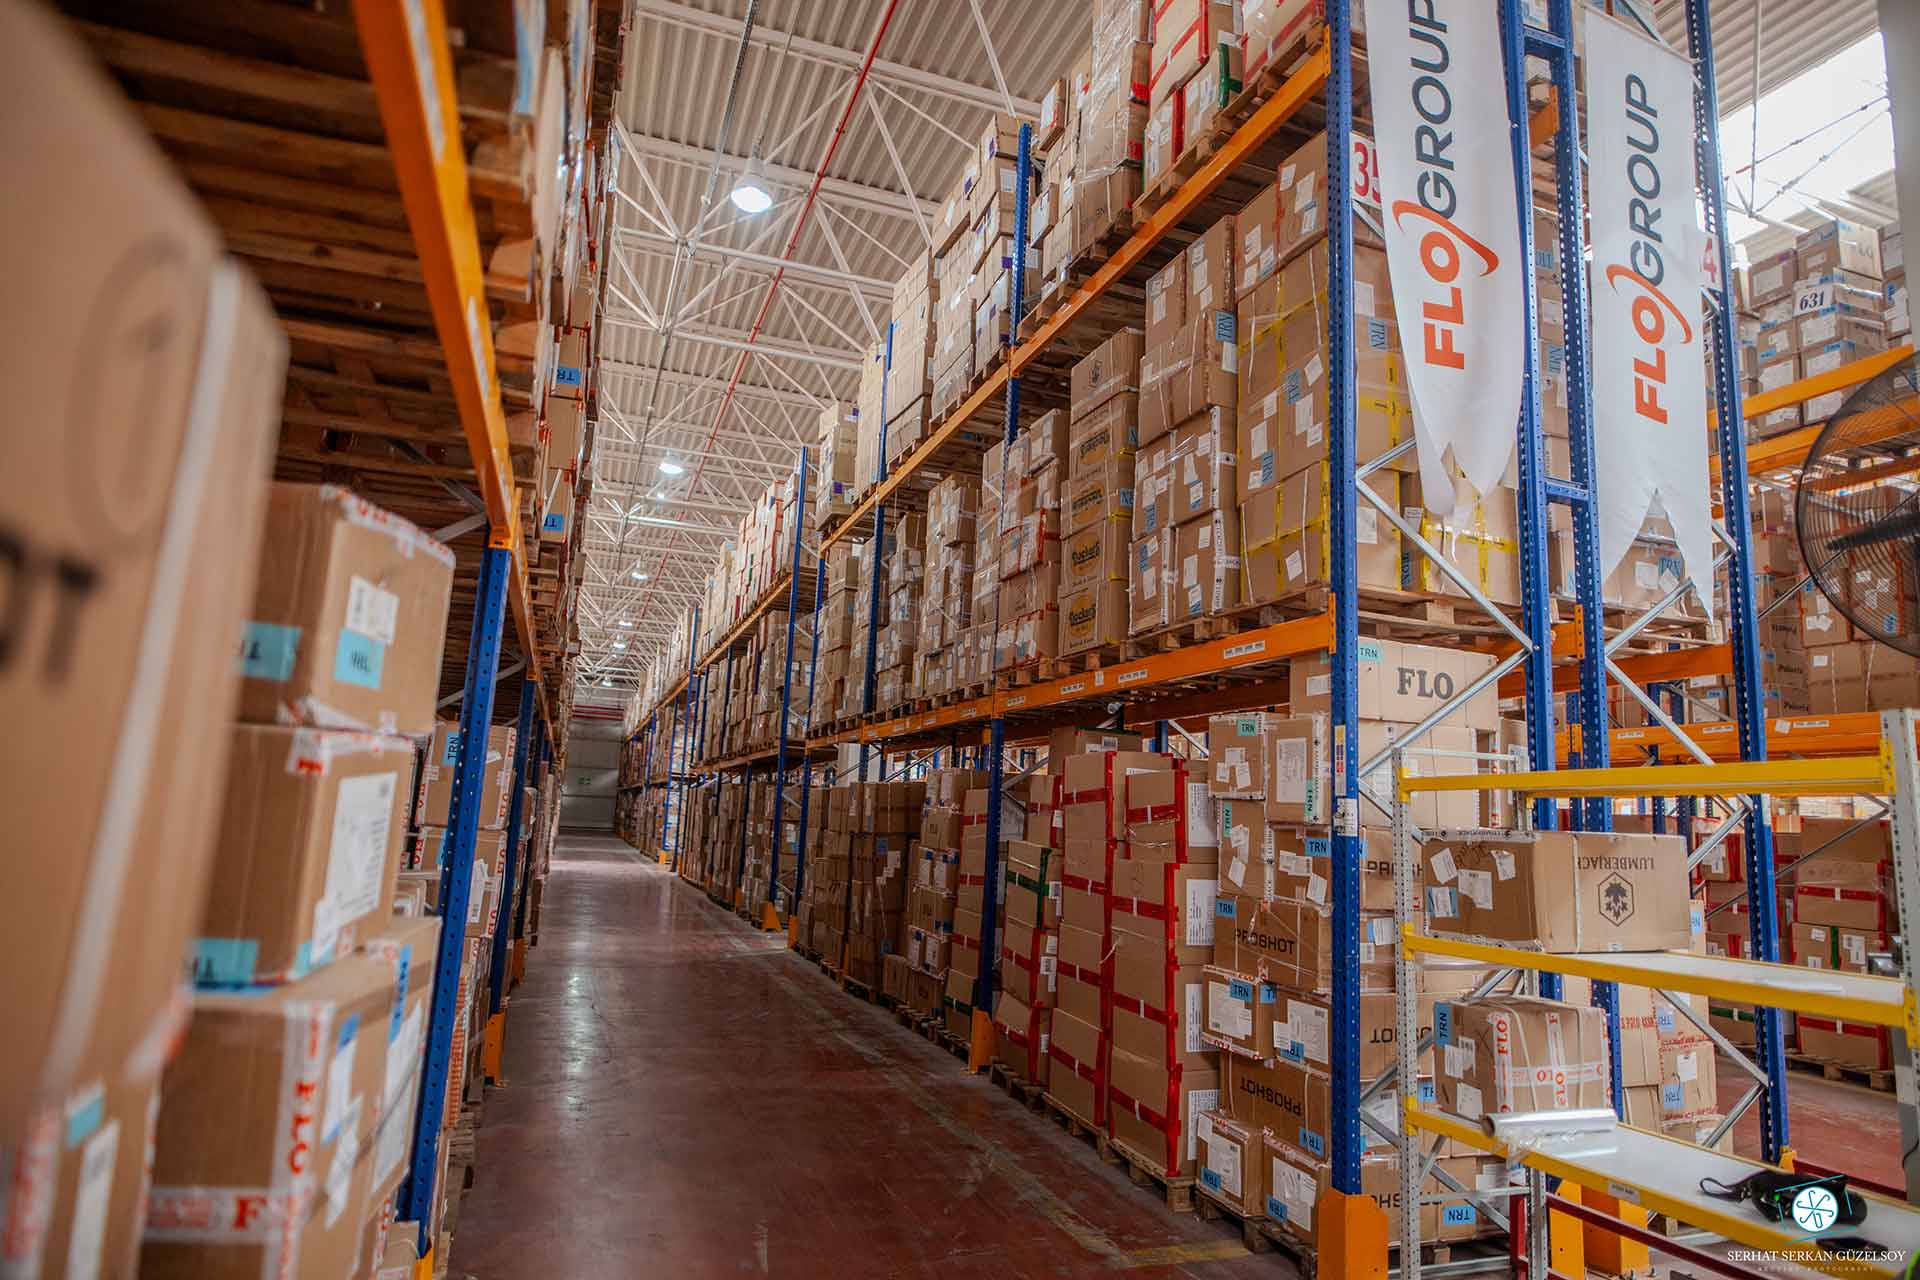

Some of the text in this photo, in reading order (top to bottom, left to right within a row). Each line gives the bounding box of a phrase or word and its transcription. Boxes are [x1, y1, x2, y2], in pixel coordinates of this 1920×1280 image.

[1408, 0, 1465, 370] FLO GROUP
[1624, 72, 1669, 425] FLO GROUP
[1799, 290, 1826, 312] 631
[1218, 313, 1234, 342] TRN
[556, 369, 576, 382] TR
[1359, 647, 1379, 658] TRN
[1397, 667, 1455, 700] FLO
[1240, 723, 1255, 733] TRN
[447, 735, 459, 761] TRN
[1308, 841, 1328, 853] TRN
[1217, 902, 1233, 914] TRN
[1234, 927, 1296, 956] PROSHOT
[1233, 984, 1250, 998] TRN
[1439, 1012, 1448, 1039] TRN
[1496, 1018, 1510, 1055] FLO
[1240, 1076, 1302, 1117] PROSHOT
[1203, 1174, 1219, 1189] TRN
[1268, 1201, 1285, 1219] TRN
[1448, 1208, 1471, 1221] TRN
